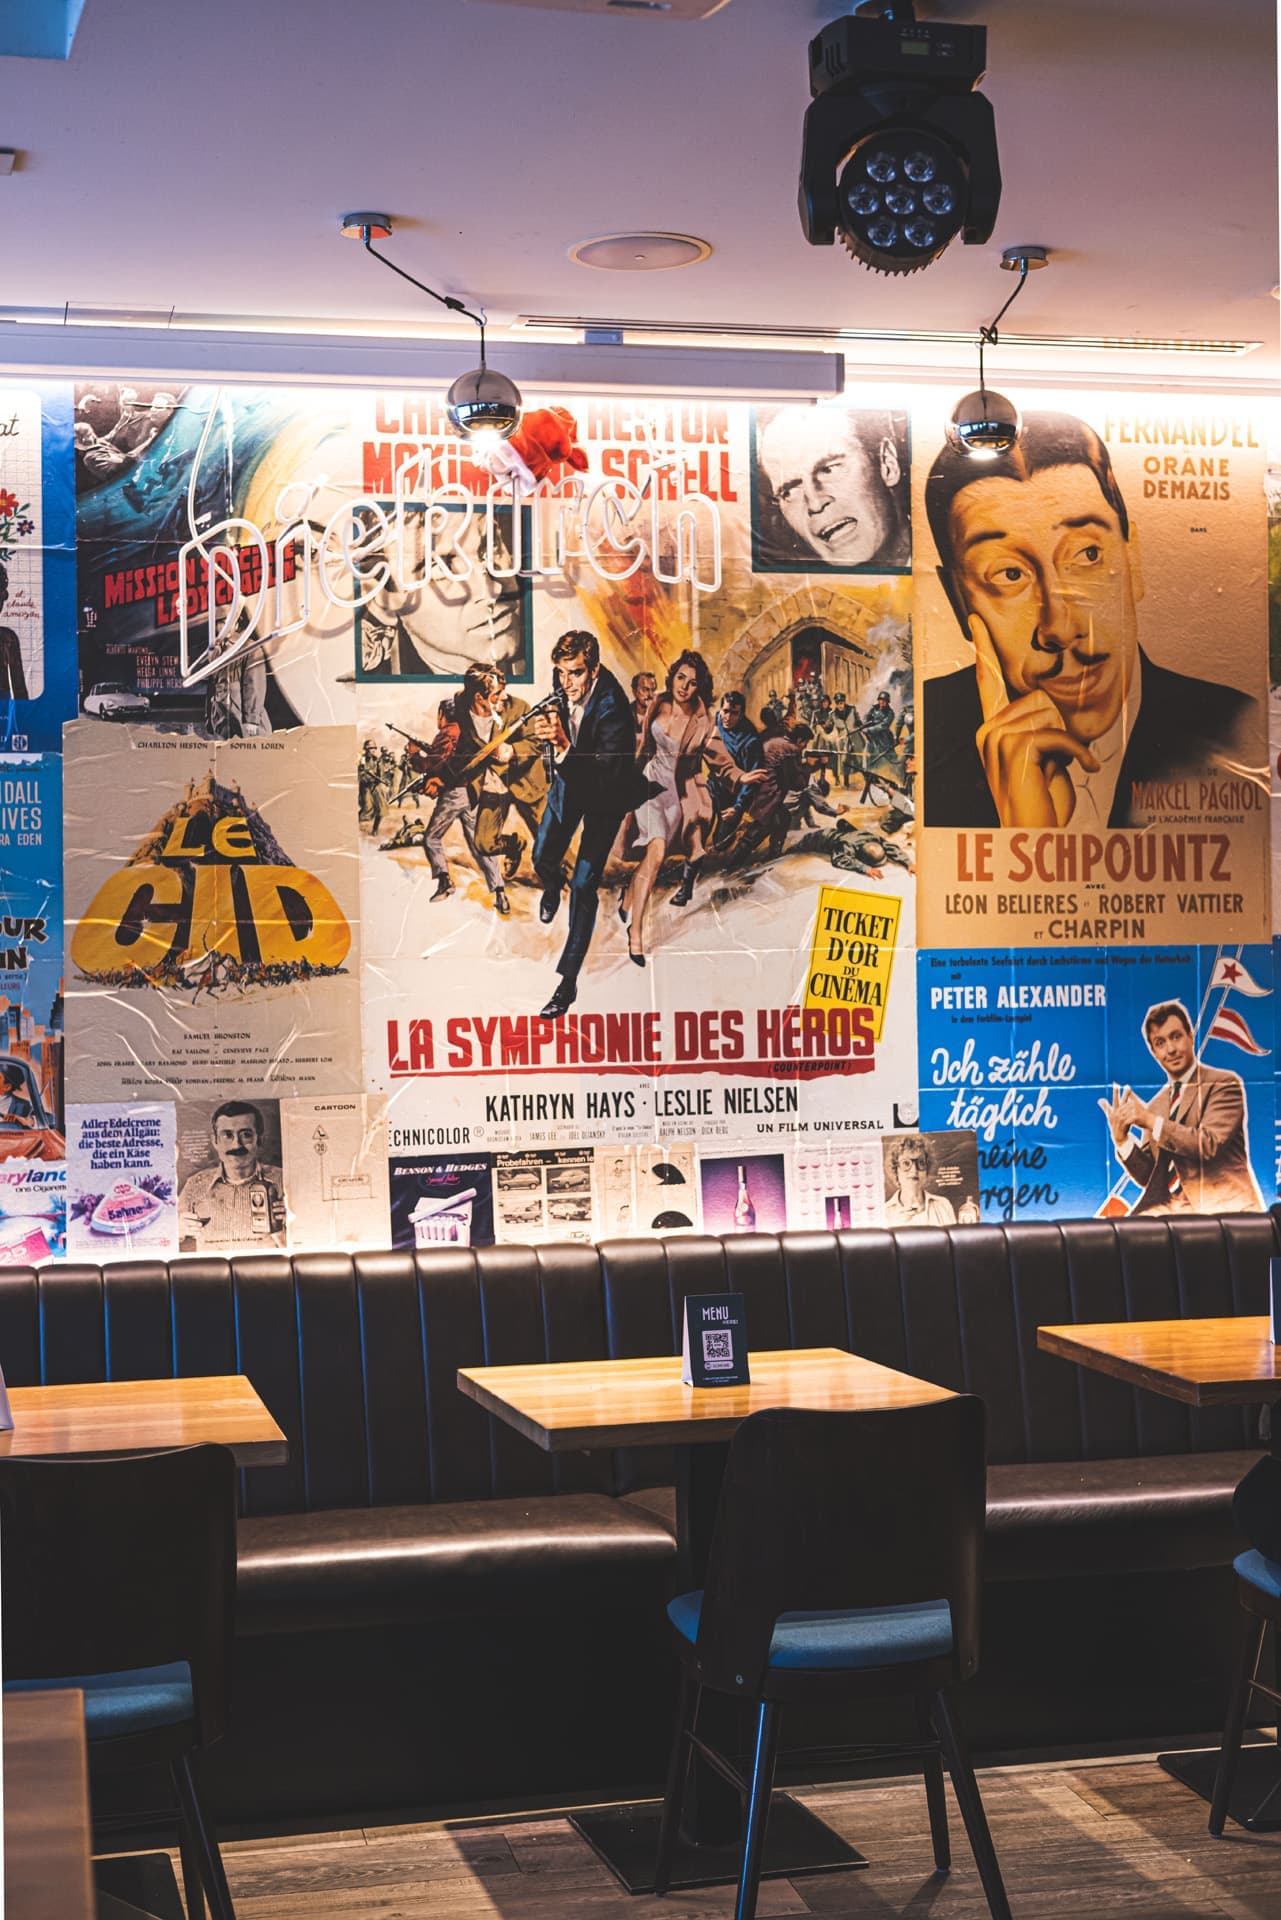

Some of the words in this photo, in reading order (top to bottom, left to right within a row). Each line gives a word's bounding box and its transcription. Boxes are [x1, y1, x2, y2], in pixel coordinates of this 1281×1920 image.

[1104, 412, 1260, 448] FERNANDEL
[1143, 456, 1230, 477] ORANE
[1143, 479, 1231, 500] DEMAZIS
[0, 781, 42, 804] DALL
[1131, 780, 1190, 810] MARCEL
[1200, 780, 1263, 810] PAGNOL
[2, 807, 42, 830] IVES
[17, 833, 42, 845] EDEN
[161, 816, 256, 858] LE
[956, 834, 994, 882] LE
[1007, 833, 1231, 883] SCHPOUNTZ
[946, 892, 988, 914] LÉON
[997, 894, 1078, 914] BELIERES
[1099, 894, 1166, 914] ROBERT
[1177, 894, 1243, 913] VATTIER
[70, 864, 351, 976] CID
[823, 907, 894, 941] TICKET
[1048, 919, 1145, 939] CHARPIN
[826, 937, 879, 967] D'OR
[843, 966, 859, 977] DU
[810, 972, 883, 1007] CINÉMA
[930, 986, 987, 1009] PETER
[997, 985, 1106, 1008] ALEXANDER
[387, 1019, 434, 1071] LA
[447, 1011, 661, 1068] SYMPHONIE
[674, 1010, 744, 1062] DES
[757, 1004, 875, 1058] HÉROS
[931, 1038, 984, 1086] Ich
[988, 1040, 1077, 1083] zähle
[314, 1103, 356, 1111] CARTOON
[486, 1094, 574, 1122] KATHRYN
[587, 1091, 635, 1119] HAYS
[655, 1089, 713, 1117] LESLIE
[724, 1086, 798, 1115] NIELSEN
[946, 1086, 1058, 1142] täglich
[81, 1118, 107, 1129] Adler
[109, 1117, 161, 1128] Edelcreme
[757, 1124, 773, 1133] UN
[779, 1122, 808, 1132] FILM
[814, 1120, 884, 1131] UNIVERSAL
[79, 1139, 93, 1149] die
[95, 1138, 120, 1149] beste
[121, 1137, 164, 1148] Adresse,
[82, 1129, 99, 1139] aus
[388, 1127, 470, 1147] CHNICOLOR
[91, 1158, 122, 1169] haben
[123, 1157, 153, 1169] kann.
[92, 1148, 108, 1159] die
[109, 1148, 125, 1159] ein
[497, 1158, 543, 1168] Probefahren
[394, 1167, 433, 1176] BENSON
[445, 1163, 488, 1173] HEDGES
[702, 1306, 729, 1320] MENU
